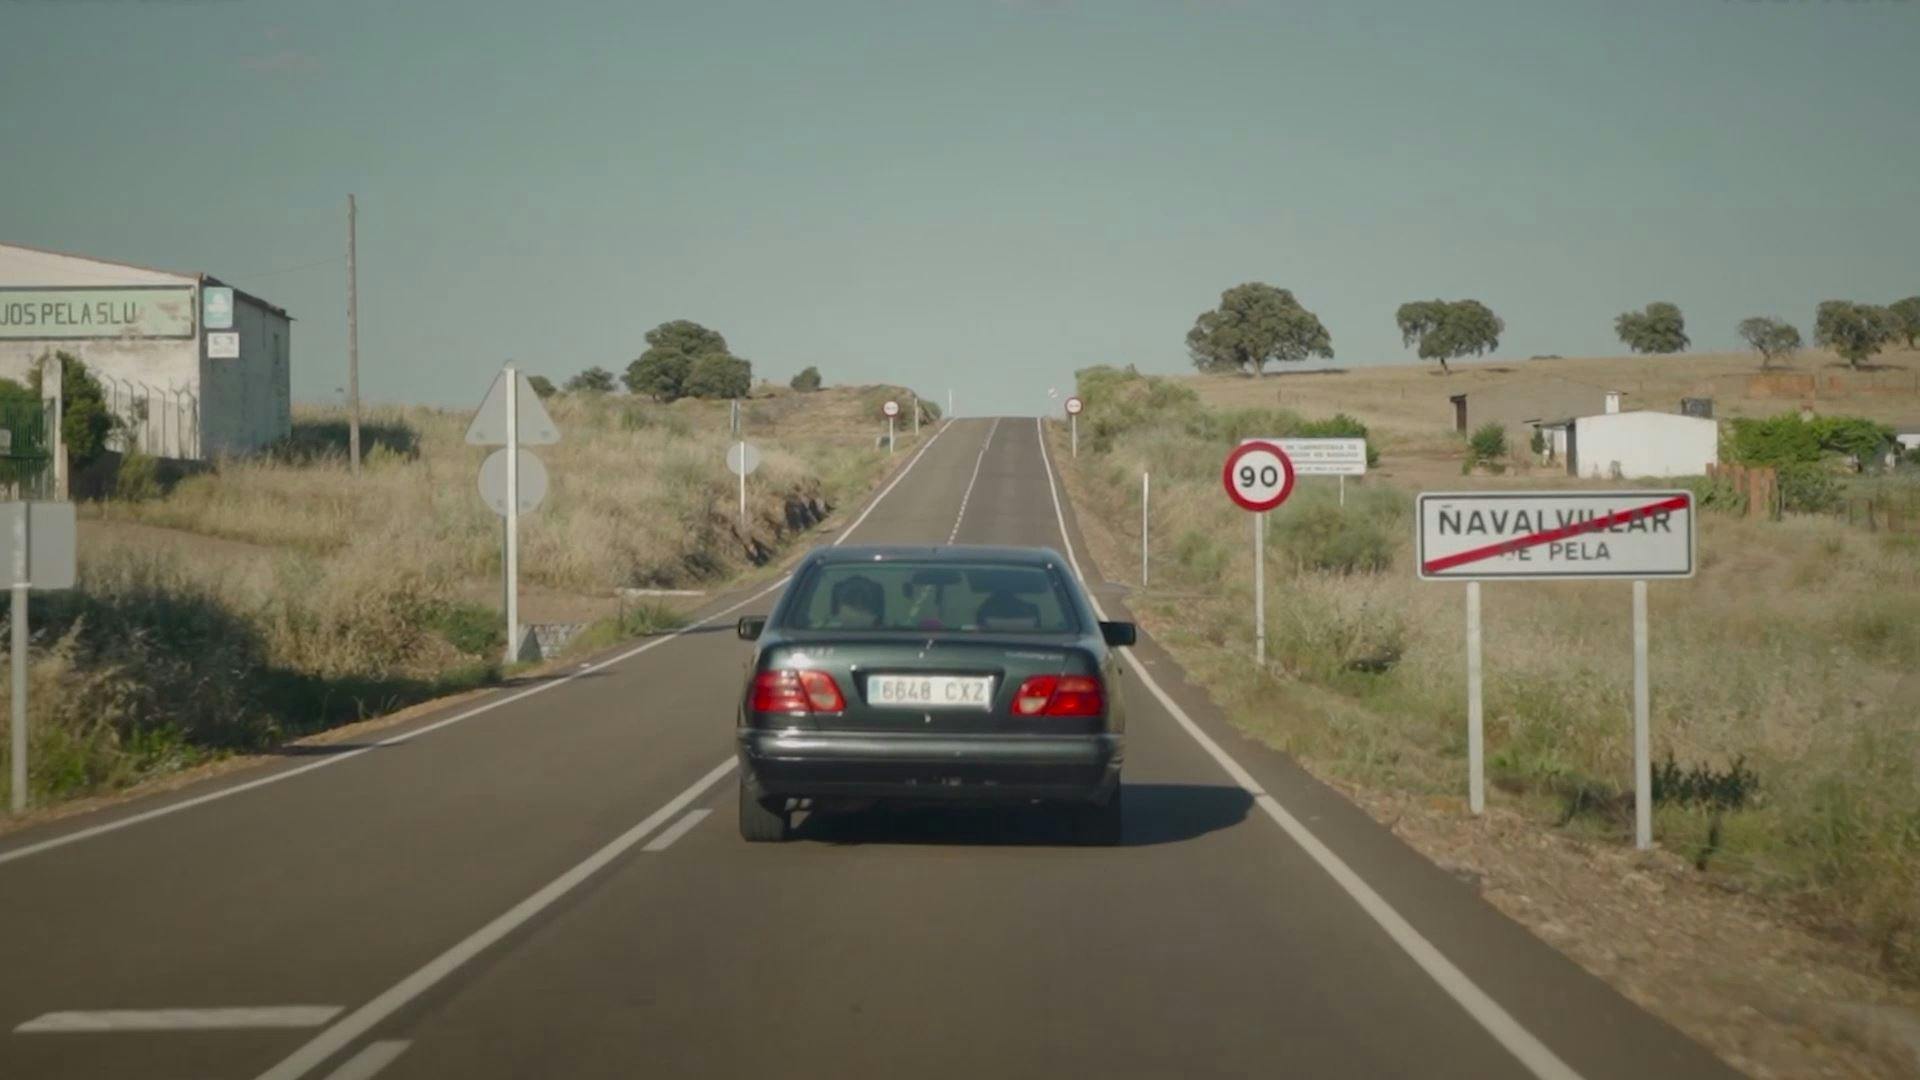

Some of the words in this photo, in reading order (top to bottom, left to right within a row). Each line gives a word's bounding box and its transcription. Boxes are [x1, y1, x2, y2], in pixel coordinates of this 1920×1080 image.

[41, 302, 92, 325] PELA
[97, 302, 136, 324] SLU
[1240, 465, 1278, 488] 90
[1549, 541, 1610, 561] PELA
